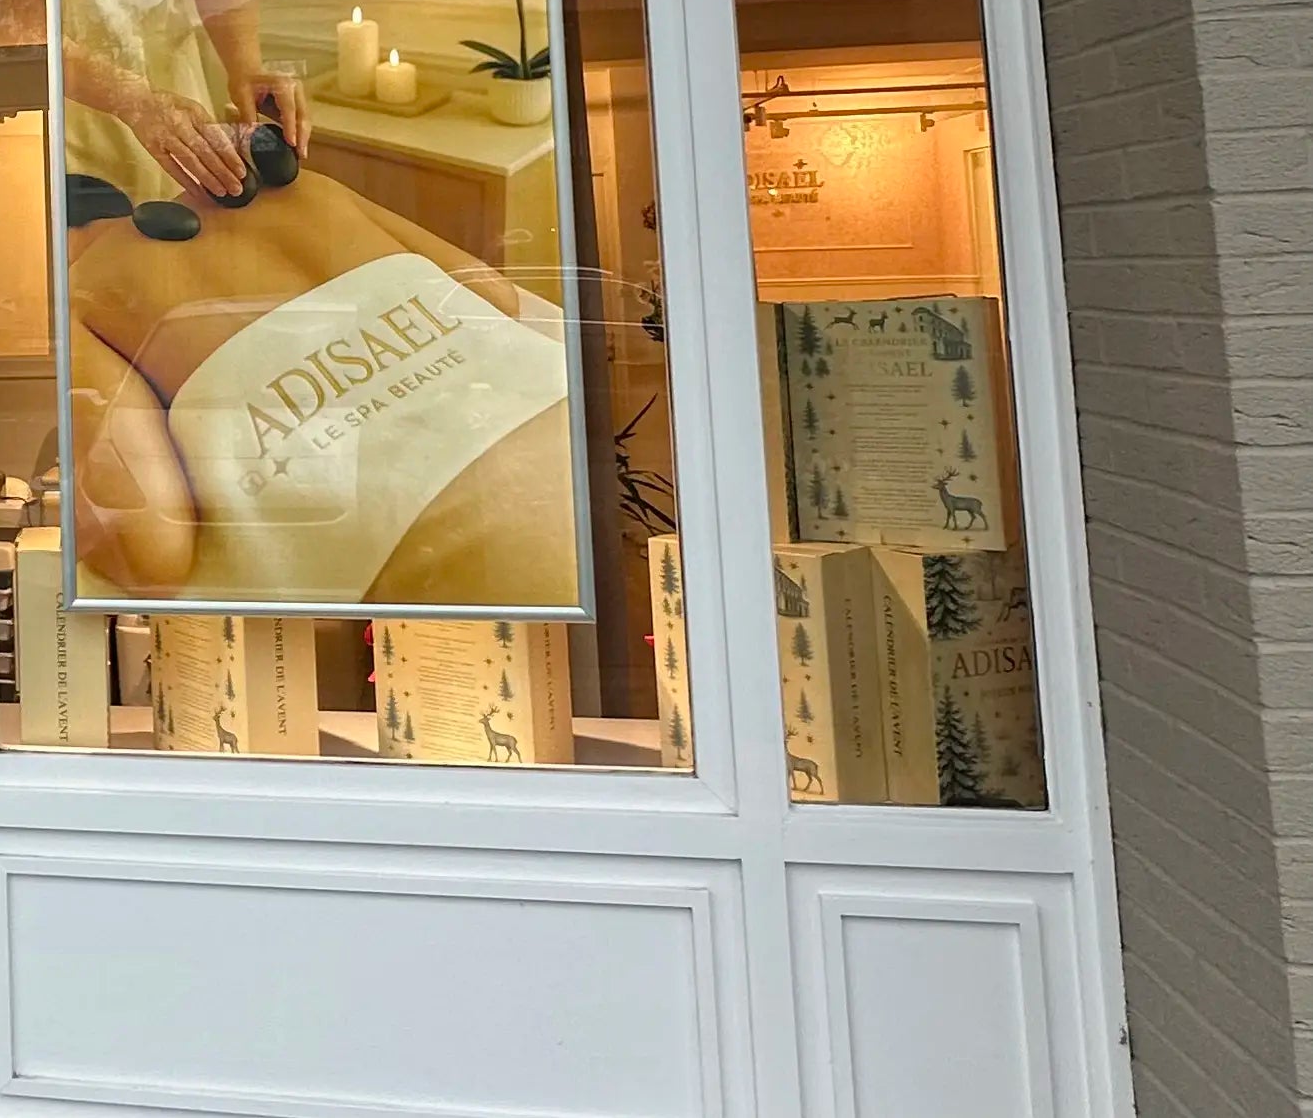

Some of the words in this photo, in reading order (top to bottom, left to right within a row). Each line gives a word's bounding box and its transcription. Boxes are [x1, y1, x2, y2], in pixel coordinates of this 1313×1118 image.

[747, 170, 825, 189] DISAEL
[247, 295, 463, 460] ADISAEL
[312, 424, 345, 450] LE
[344, 397, 390, 428] SPA
[387, 348, 467, 400] BEAUTÉ
[55, 592, 68, 668] CALENDRIER
[273, 617, 284, 662] NDRIER
[57, 671, 68, 689] DE
[275, 665, 285, 682] DE
[951, 645, 1033, 680] ADISA
[57, 692, 69, 742] L'AVENT
[277, 685, 288, 735] L'AVENT
